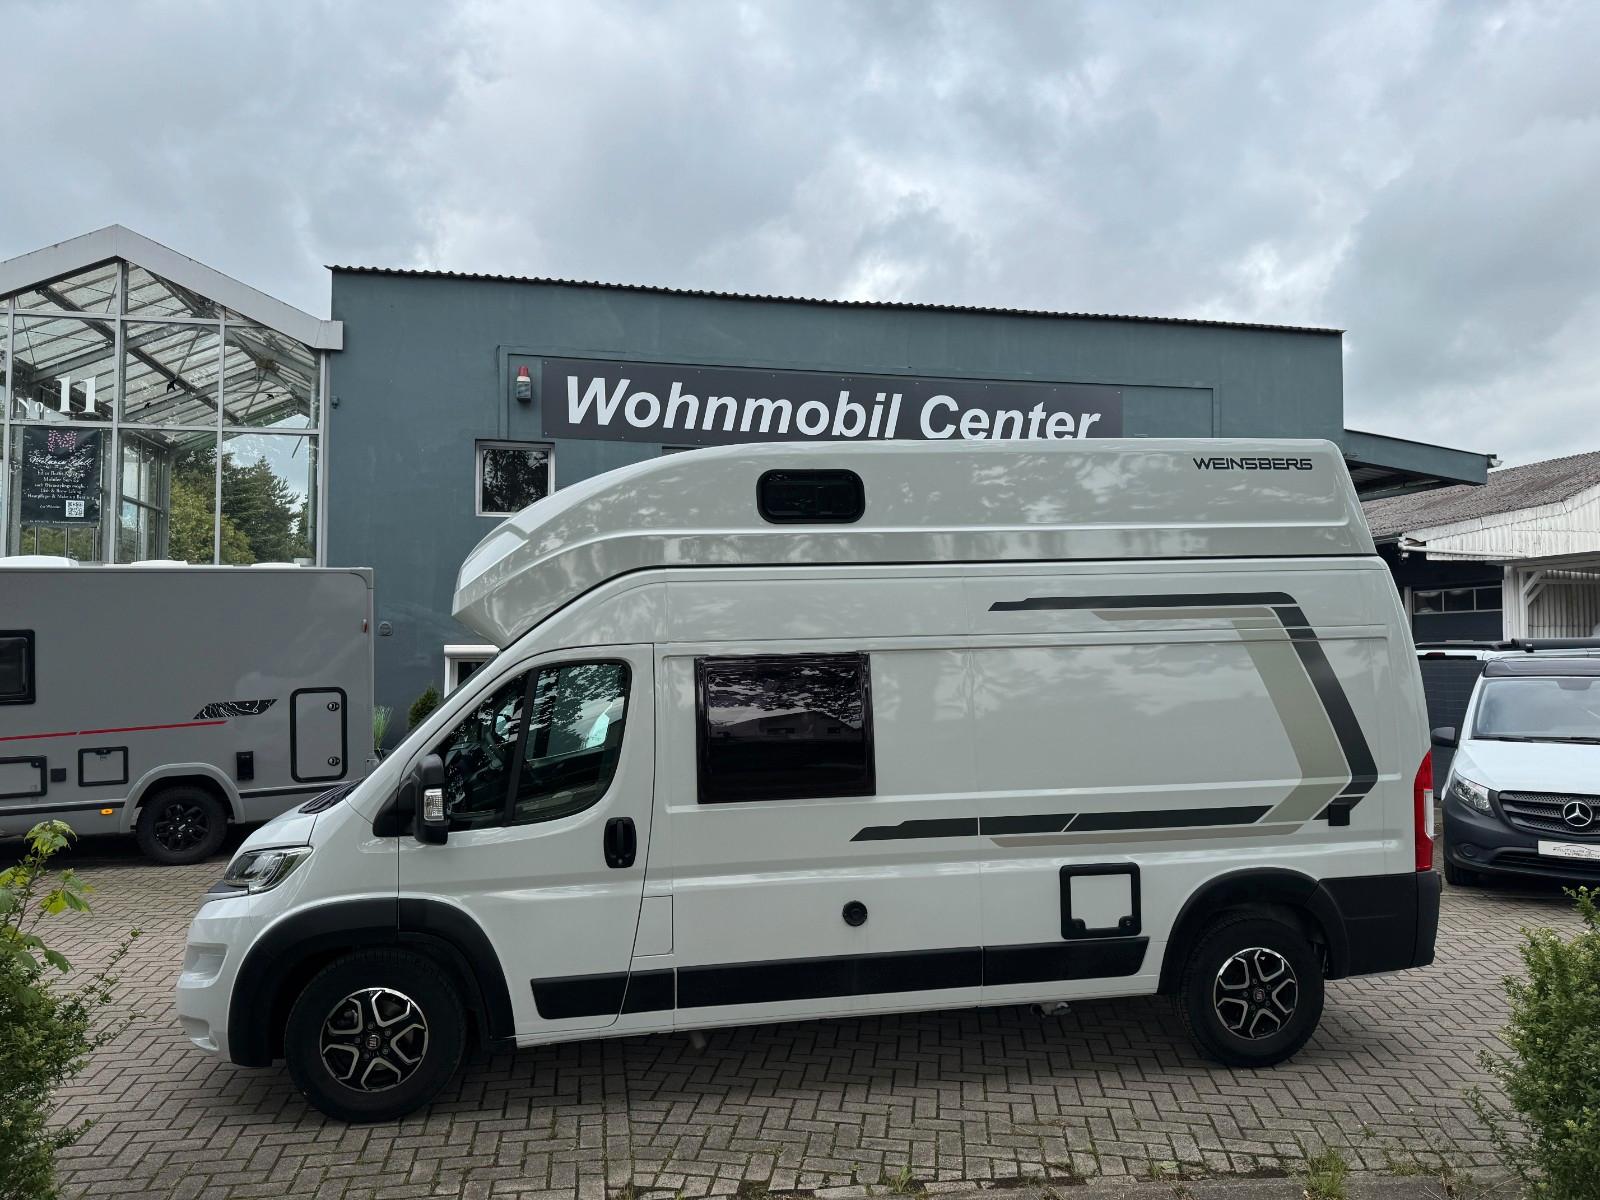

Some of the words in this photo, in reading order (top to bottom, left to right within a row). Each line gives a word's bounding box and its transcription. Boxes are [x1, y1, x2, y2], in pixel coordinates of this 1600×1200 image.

[55, 376, 97, 413] 11
[566, 375, 903, 439] Wohnmobil
[919, 395, 1101, 440] Center
[1192, 457, 1313, 471] WEINSBERG
